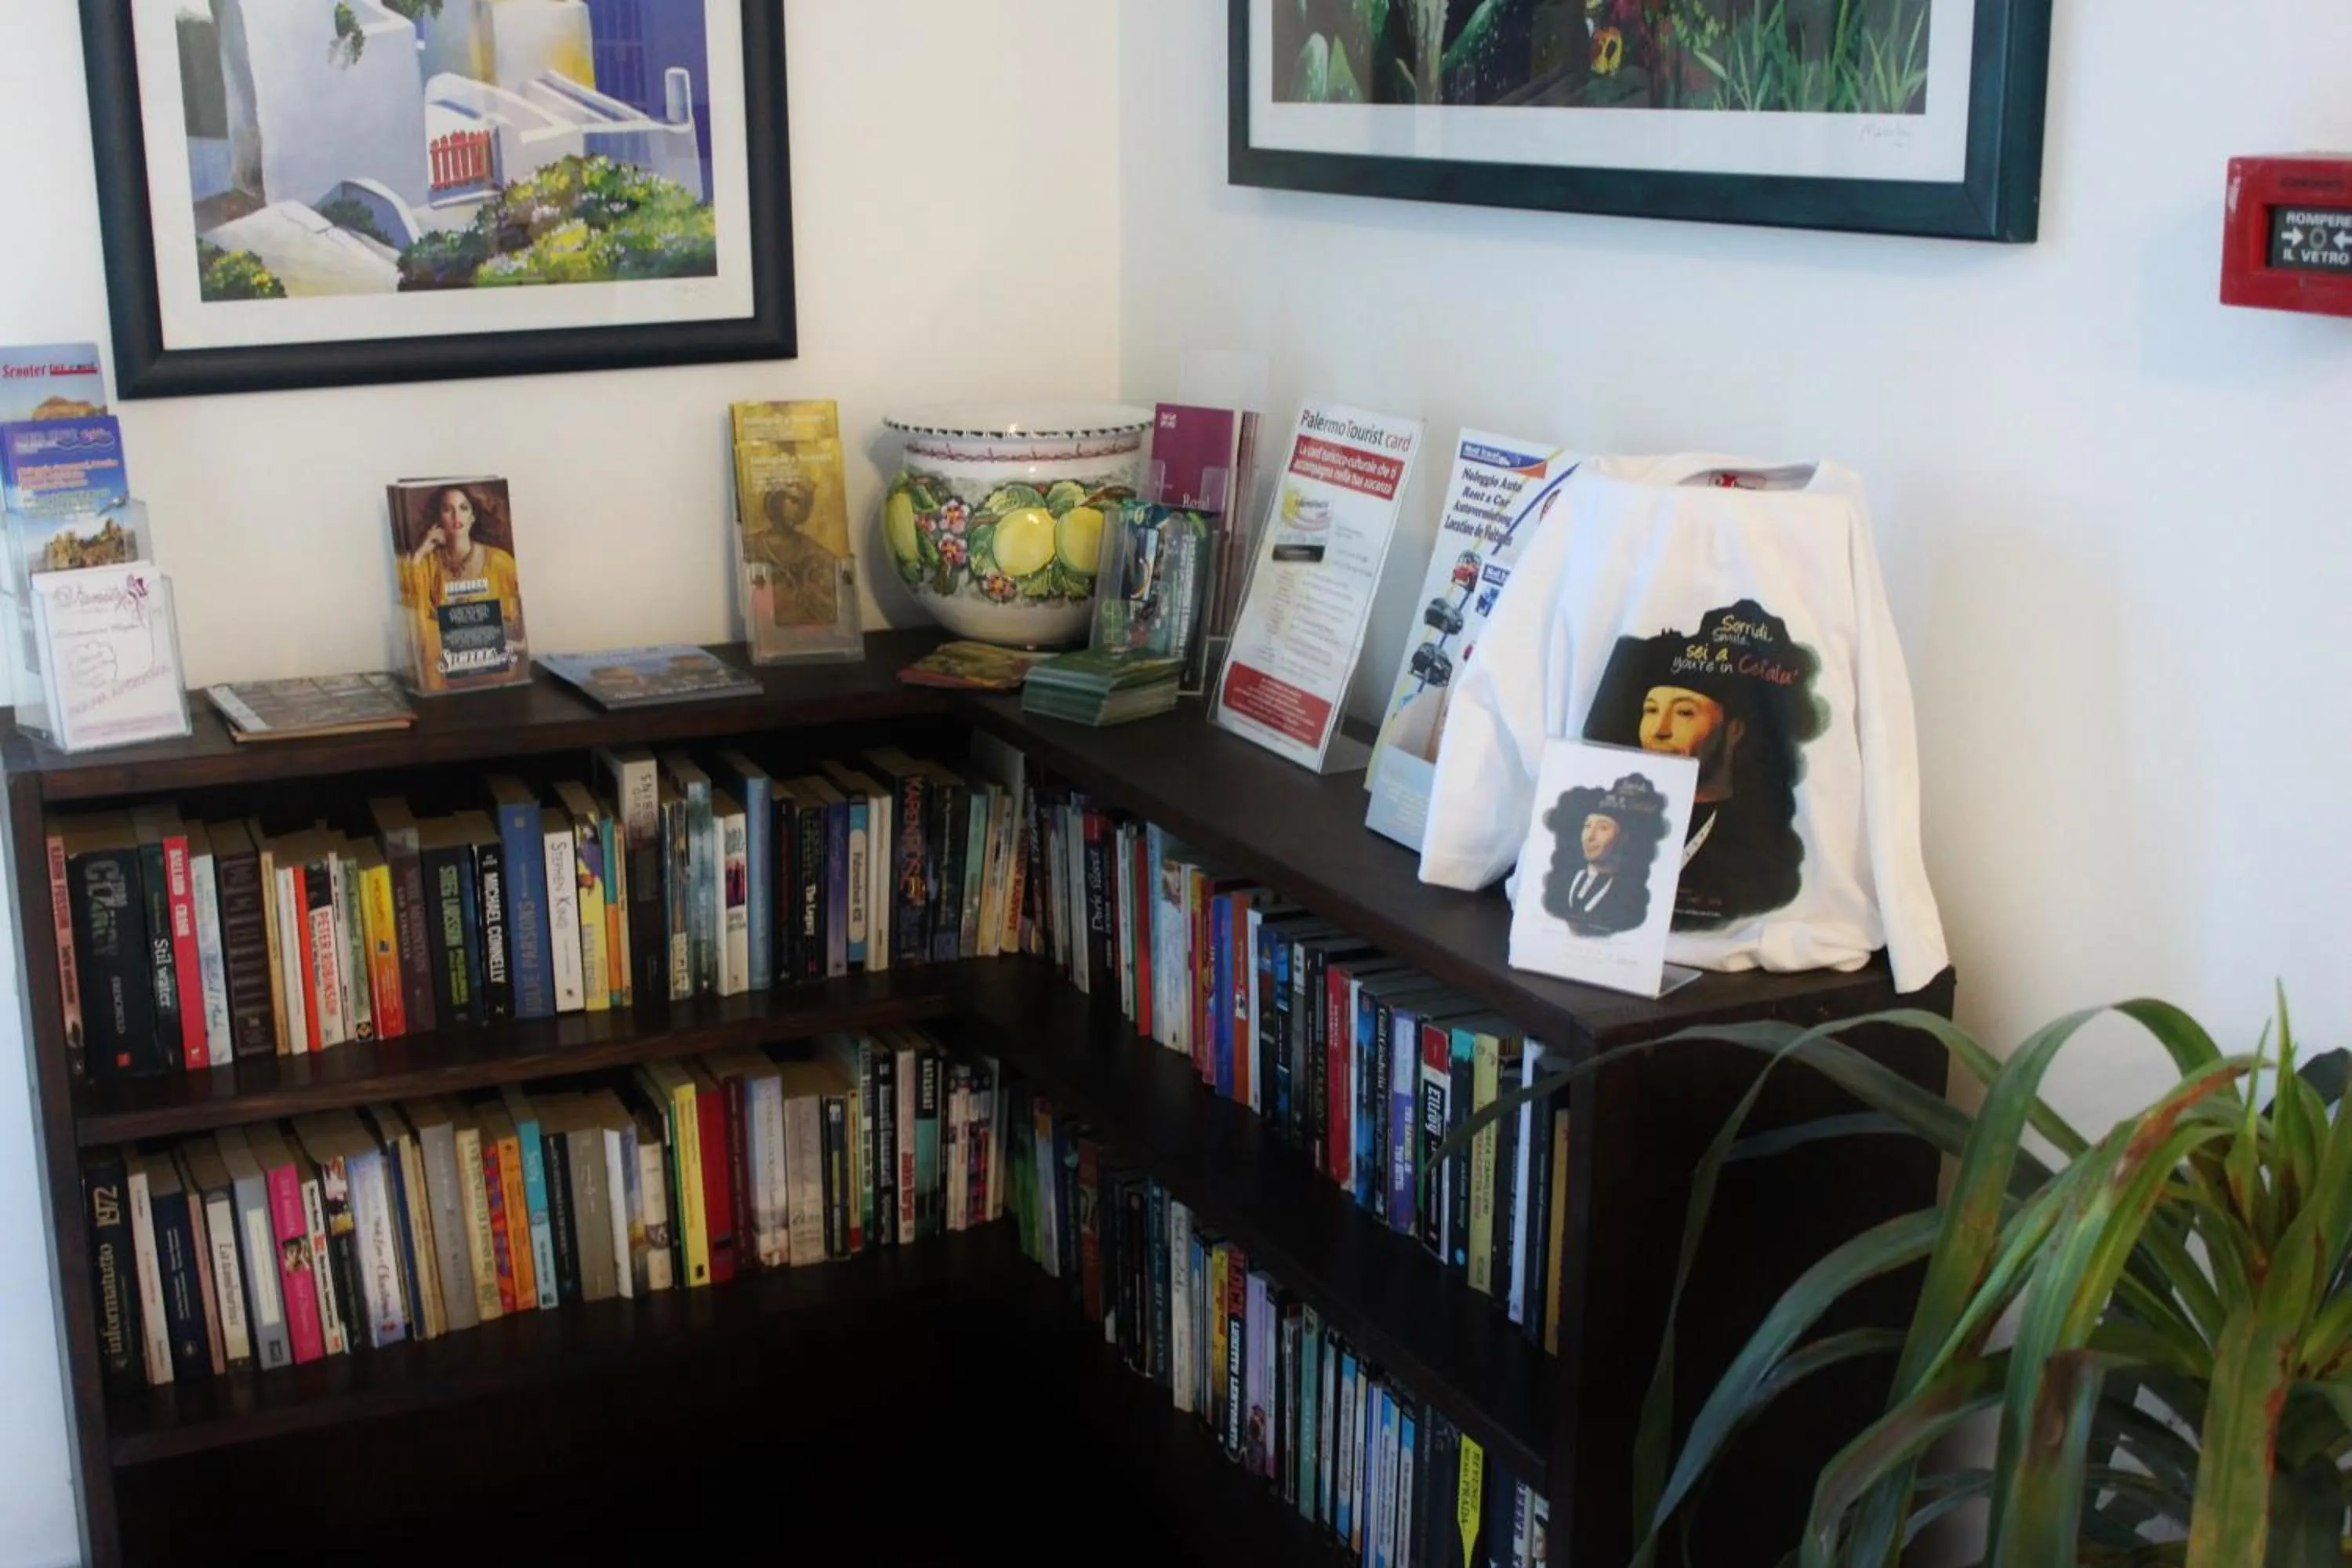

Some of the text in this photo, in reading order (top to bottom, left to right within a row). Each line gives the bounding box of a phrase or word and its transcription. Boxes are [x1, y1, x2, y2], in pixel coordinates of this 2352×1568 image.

[2285, 210, 2352, 228] ROMPERE
[2283, 248, 2350, 265] IL VETRO
[1385, 430, 1413, 452] card
[1461, 467, 1523, 493] Noleggio Auto
[1462, 485, 1485, 502] Rent
[1493, 493, 1512, 508] Car
[1686, 644, 1730, 662] sei a
[1719, 661, 1734, 674] in
[484, 872, 506, 983] MICHAEL CONNELLY
[1426, 1083, 1443, 1138] Ellroy
